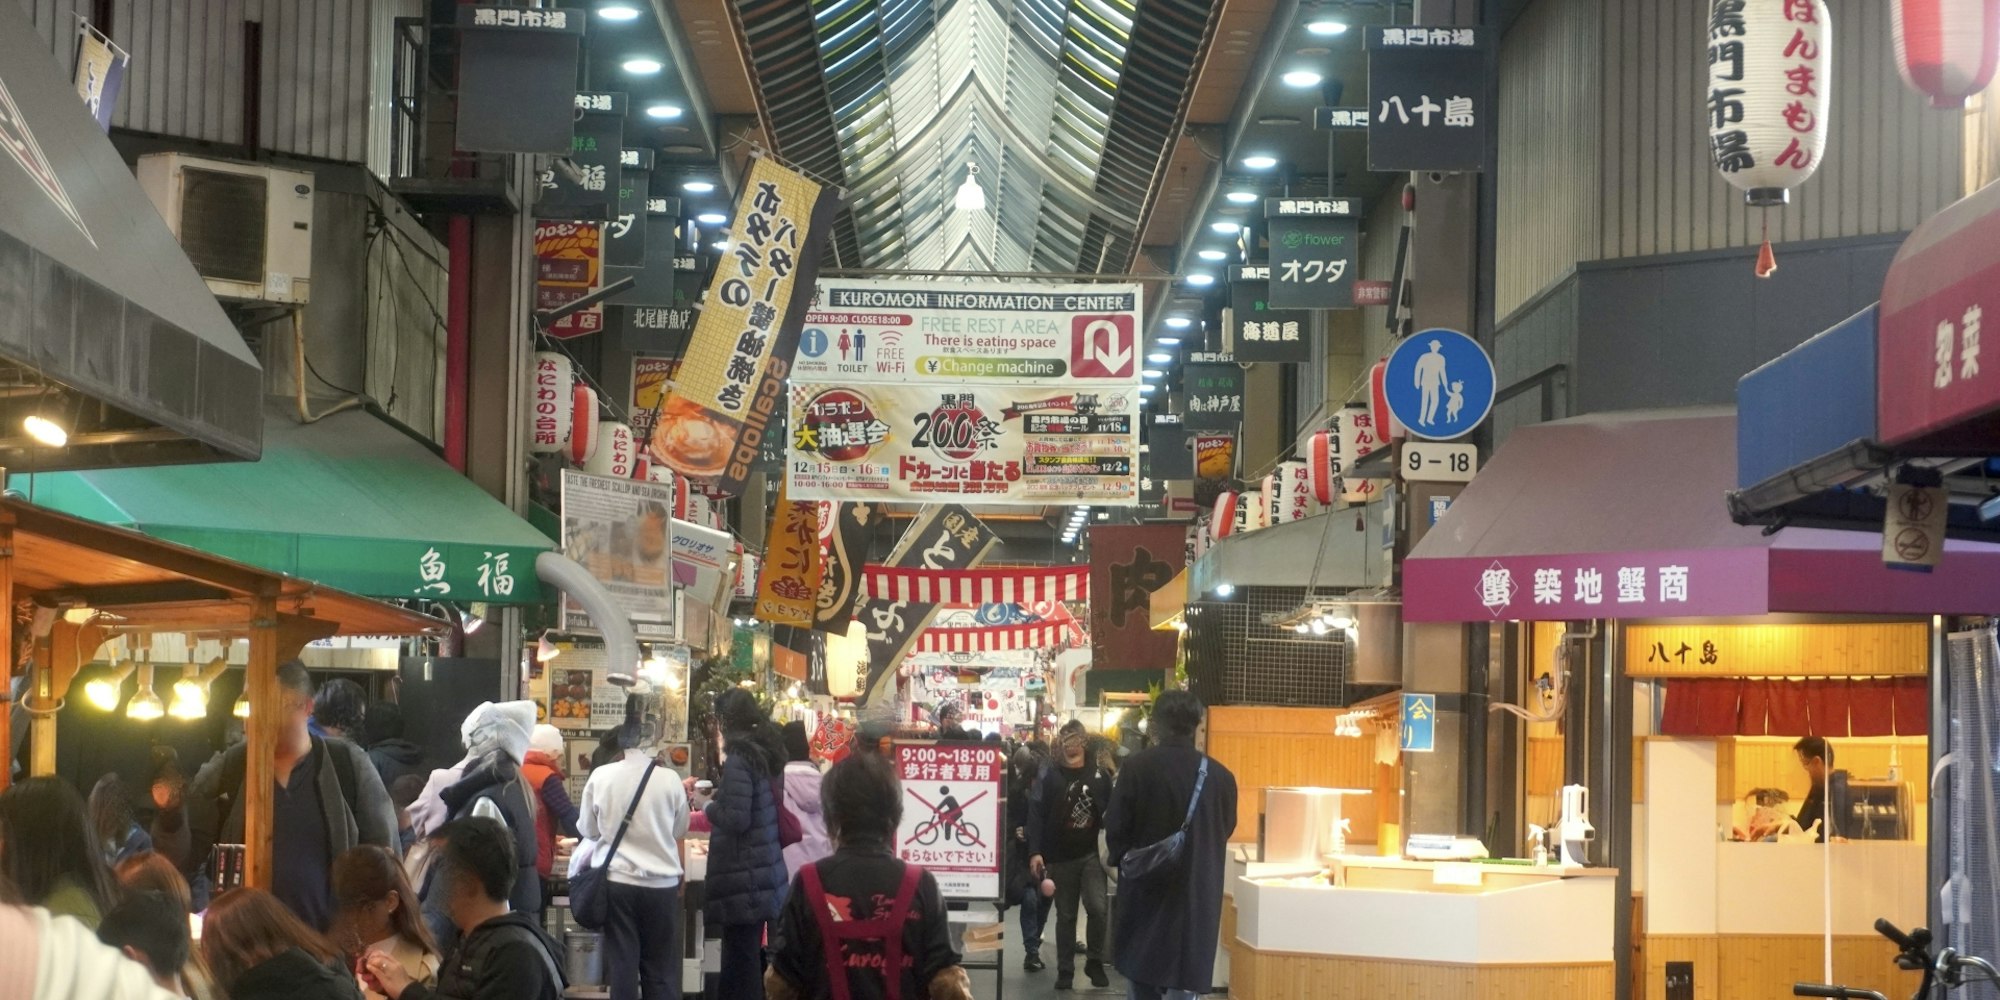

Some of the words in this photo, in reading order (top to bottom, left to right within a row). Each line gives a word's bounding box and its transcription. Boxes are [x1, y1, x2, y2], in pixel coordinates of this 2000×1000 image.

[475, 8, 567, 29] 黒門市場
[1382, 28, 1475, 46] 黒門市場
[1708, 0, 1755, 172] 黒門市場
[1774, 0, 1818, 170] ほんまもん
[1378, 95, 1475, 127] 八十島
[646, 199, 667, 212] 場
[1279, 200, 1349, 214] 黒門市場
[1304, 233, 1344, 245] flower
[1281, 258, 1348, 284] オクダ
[840, 291, 928, 308] KUROMON
[938, 293, 1054, 311] INFORMATION
[1064, 296, 1124, 312] CENTER
[806, 314, 828, 323] OPEN
[830, 315, 848, 323] 9:00
[921, 316, 961, 333] FREE
[967, 318, 1004, 333] REST
[1011, 319, 1060, 335] AREA
[924, 334, 960, 346] There
[963, 334, 973, 347] is
[976, 337, 1017, 350] eating
[1021, 339, 1057, 350] space
[877, 348, 905, 360] FREE
[838, 364, 868, 373] TOILET
[877, 361, 905, 374] Wi-Fi
[942, 358, 993, 374] Change
[997, 360, 1054, 373] machine
[942, 393, 975, 410] 黒門
[794, 418, 891, 452] 大抽選会
[1198, 438, 1225, 450] クロモン
[414, 547, 513, 595] 魚福
[1534, 565, 1688, 604] 築地蟹商
[1648, 640, 1719, 665] 八十島
[901, 748, 995, 763] 9:00～18:00
[904, 764, 991, 780] 歩行者専用
